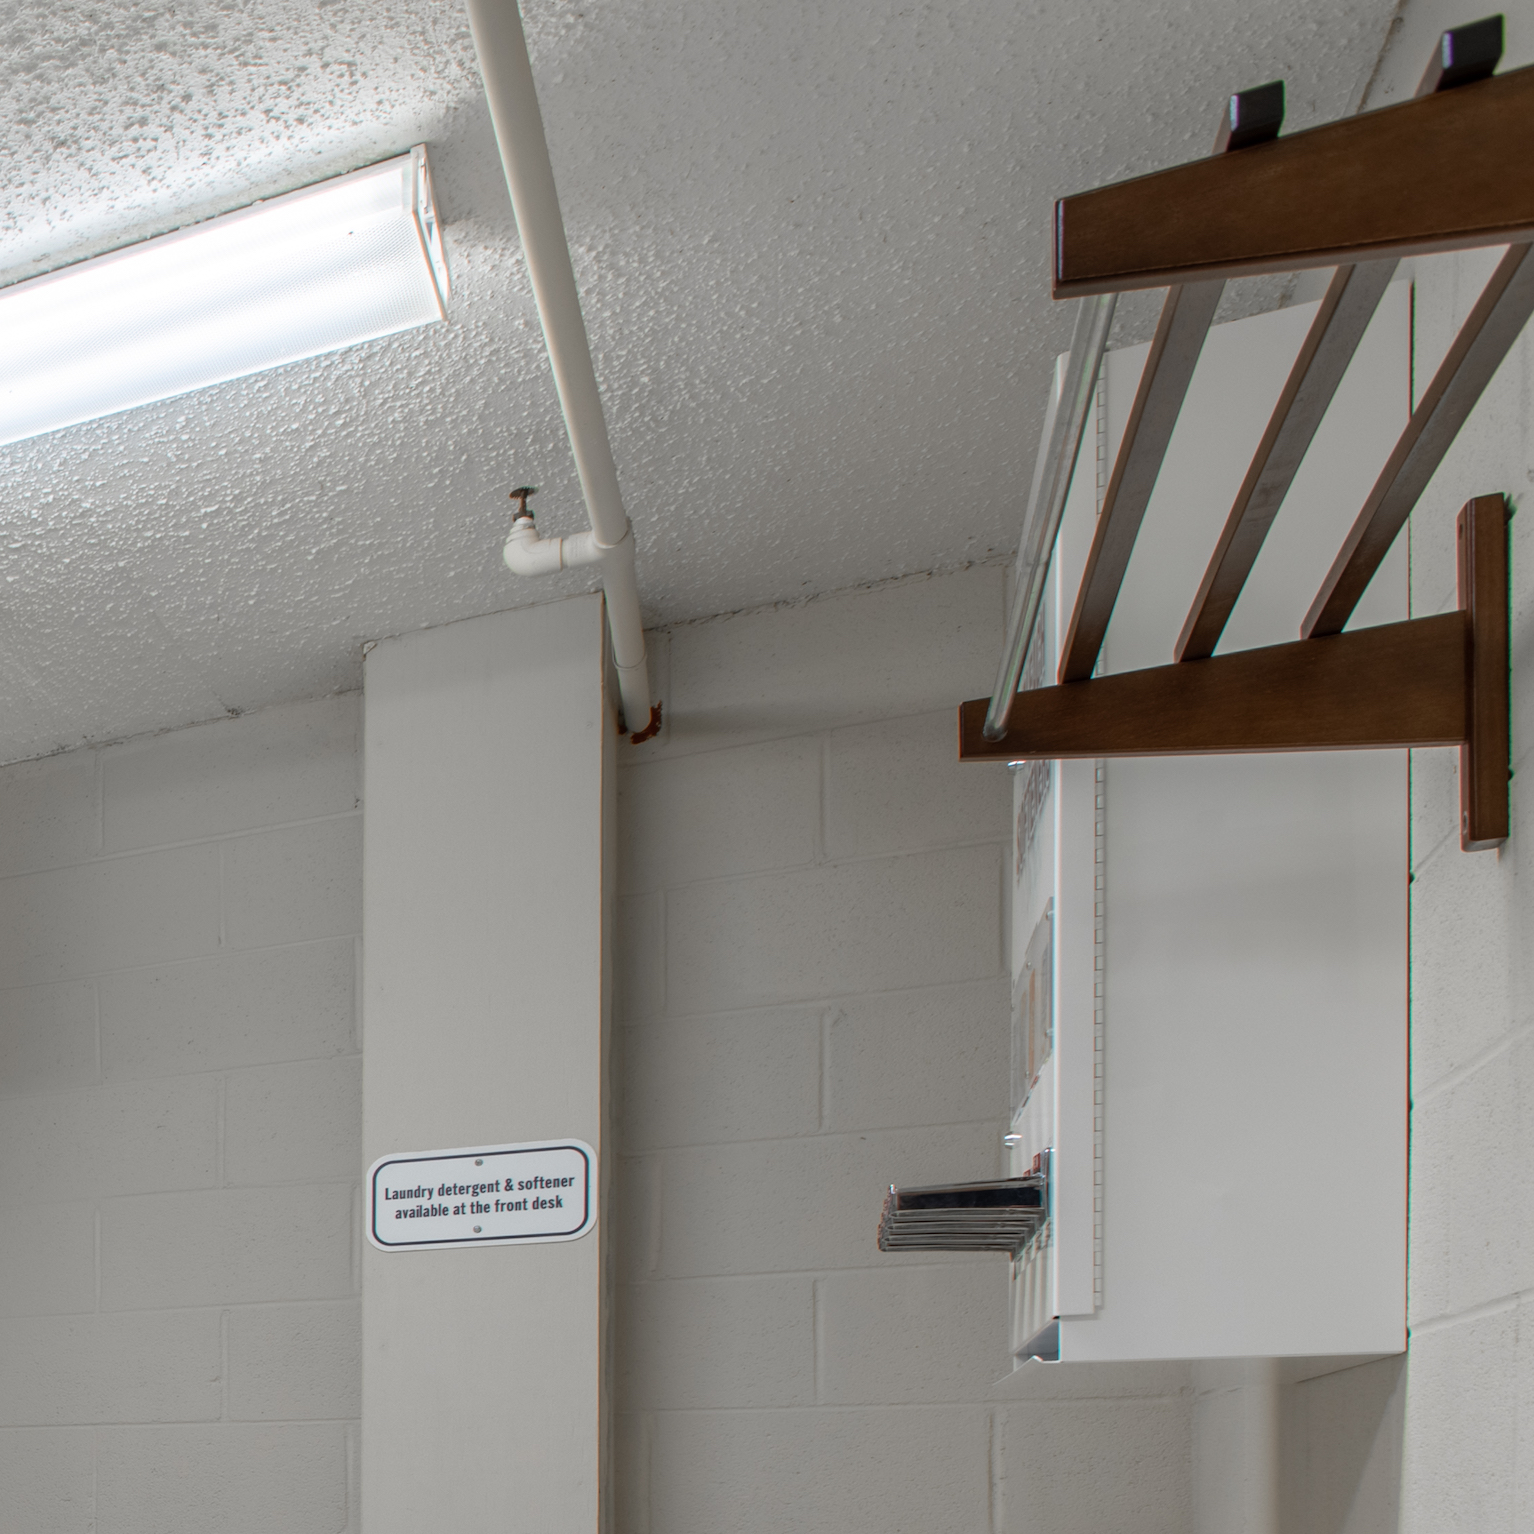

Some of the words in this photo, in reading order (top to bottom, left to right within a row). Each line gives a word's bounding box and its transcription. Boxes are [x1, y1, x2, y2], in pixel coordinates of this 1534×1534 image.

[385, 1185, 433, 1200] Laundry
[437, 1179, 500, 1197] detergent
[504, 1178, 514, 1191] &
[517, 1175, 575, 1190] softener
[395, 1203, 449, 1219] available
[452, 1202, 466, 1215] at
[469, 1200, 490, 1214] the
[494, 1198, 528, 1212] front
[532, 1194, 562, 1210] desk
